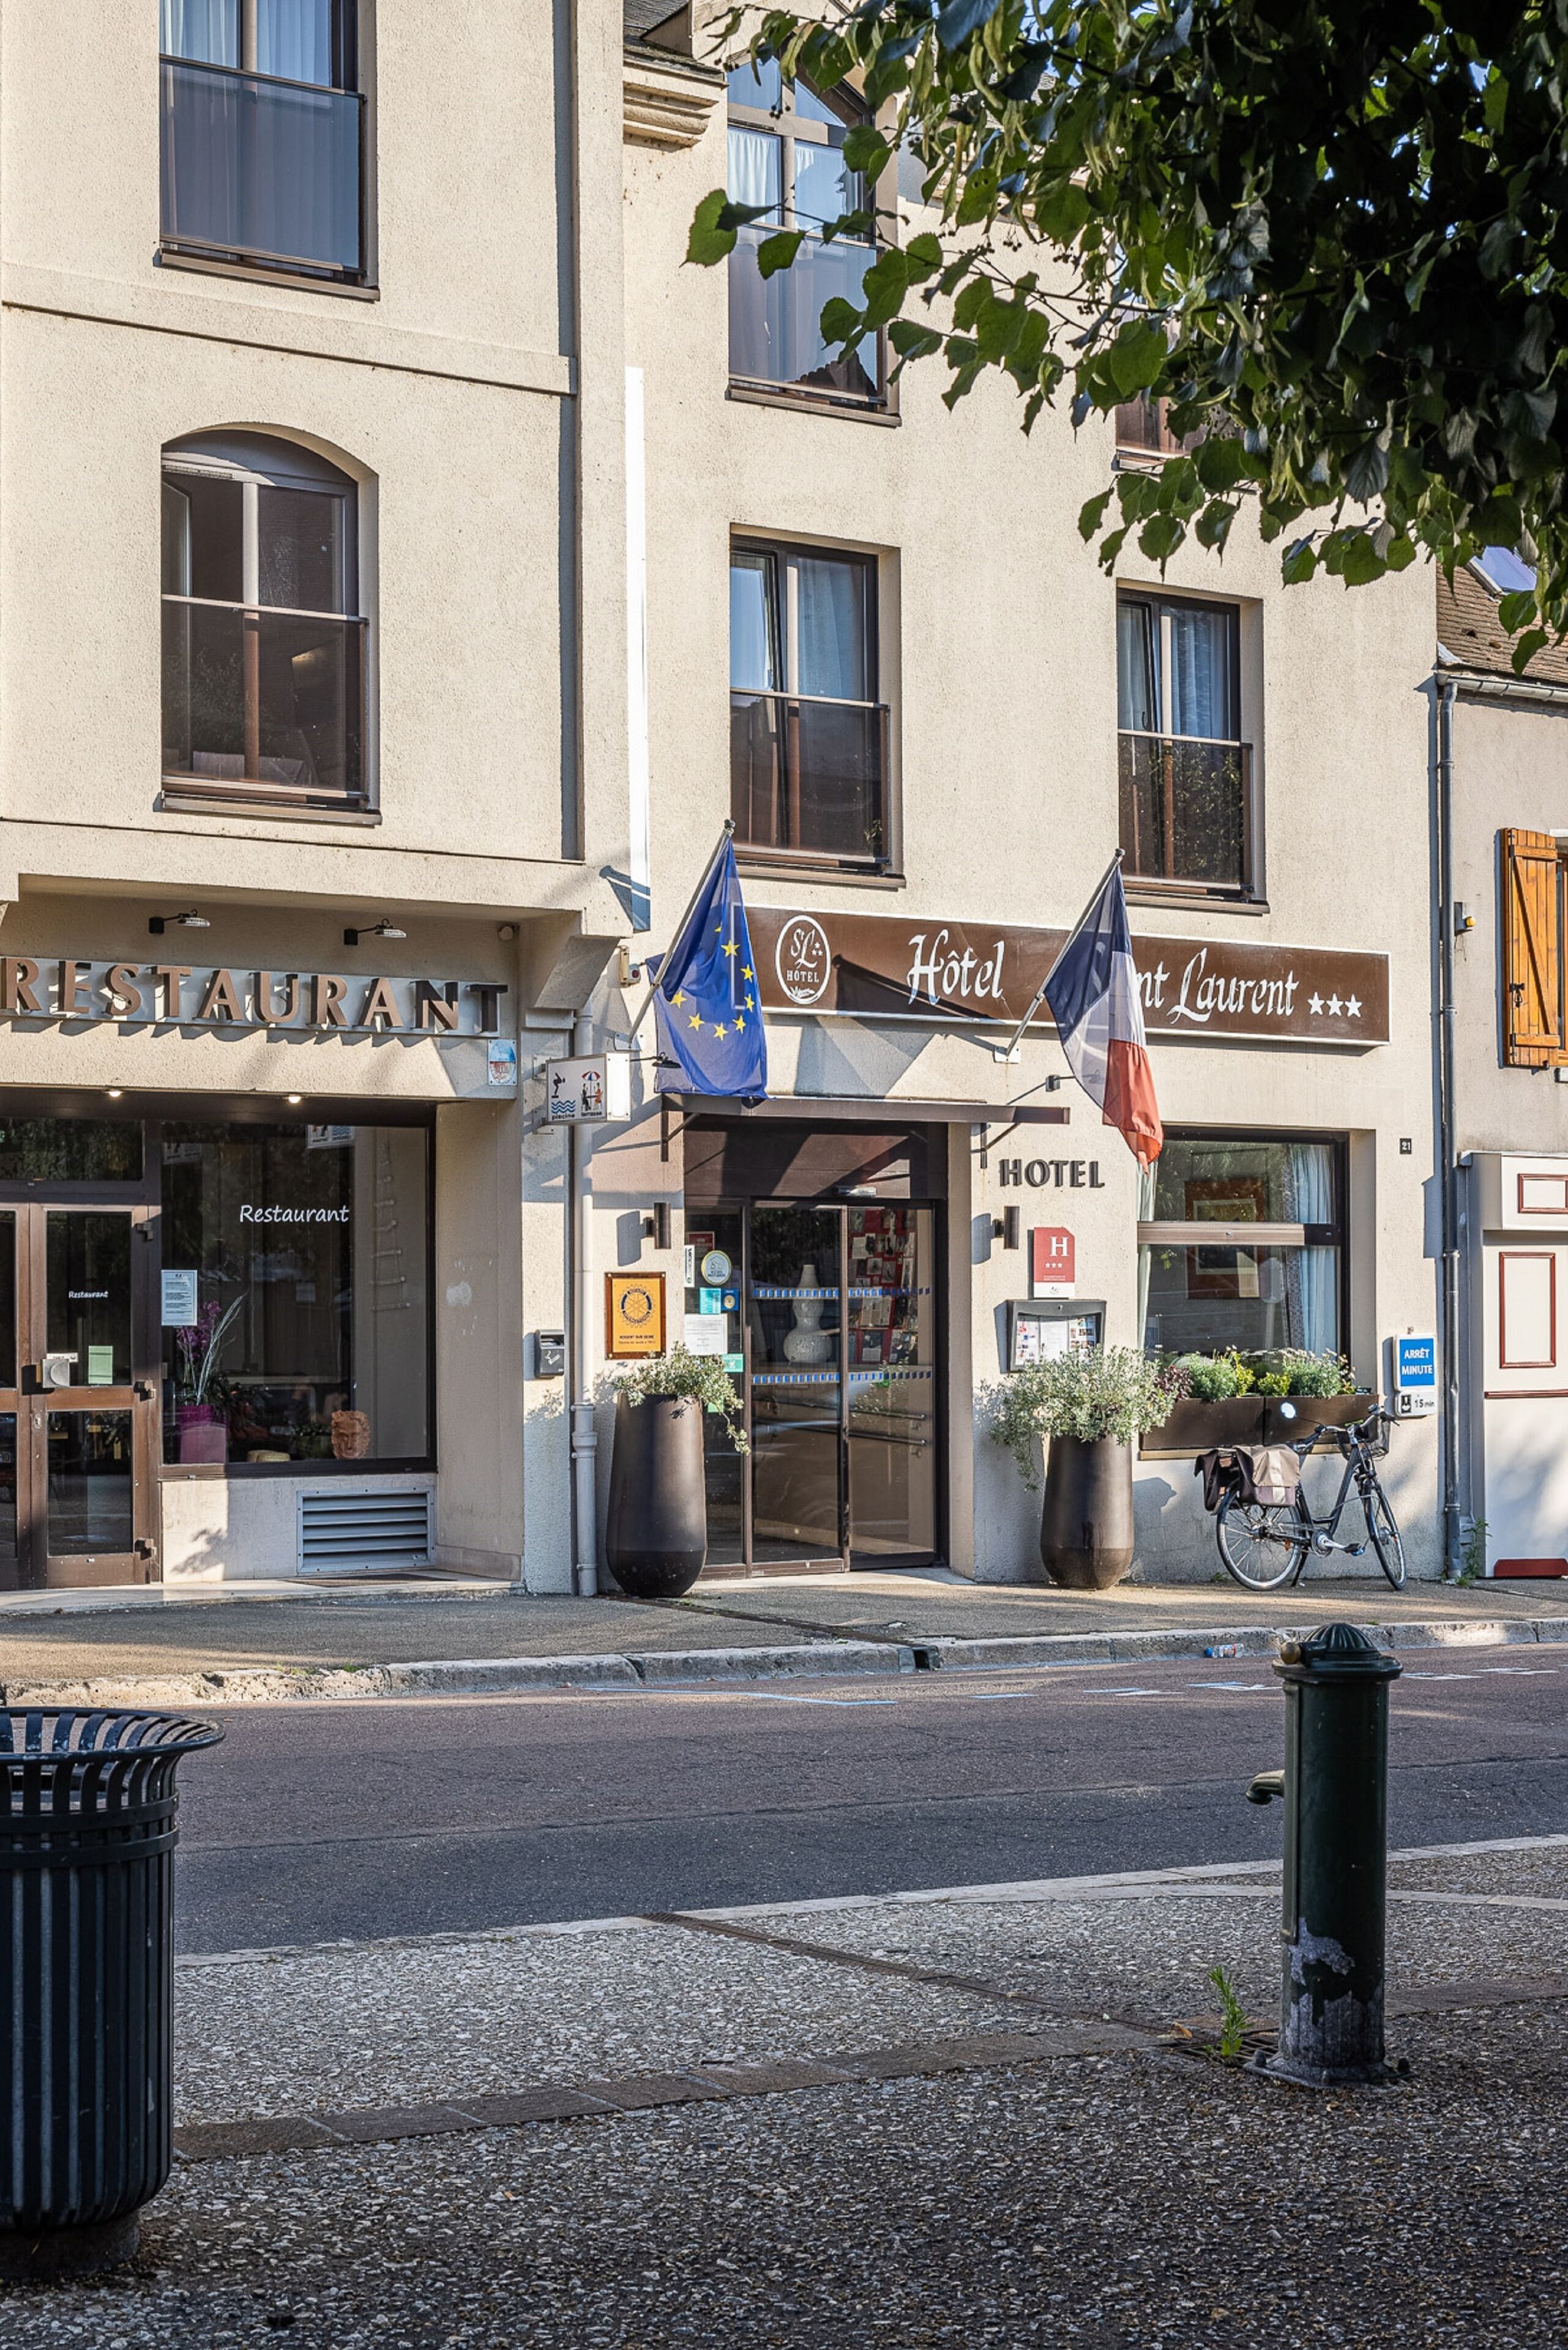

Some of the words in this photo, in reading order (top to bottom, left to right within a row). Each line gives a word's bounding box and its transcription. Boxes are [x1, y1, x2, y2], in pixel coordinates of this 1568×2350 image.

[786, 968, 819, 983] HÔTEL
[907, 929, 1005, 1005] Hôtel
[1167, 947, 1299, 1024] Laurent
[0, 957, 509, 1032] RESTAURANT
[1402, 1141, 1411, 1151] 21
[999, 1159, 1105, 1188] HOTEL
[239, 1204, 349, 1223] Restaurant
[1049, 1236, 1069, 1256] H
[68, 1290, 109, 1299] Restaurant
[1404, 1347, 1430, 1359] ARRÊT
[1402, 1365, 1433, 1376] MINUTE
[1414, 1399, 1424, 1408] 15
